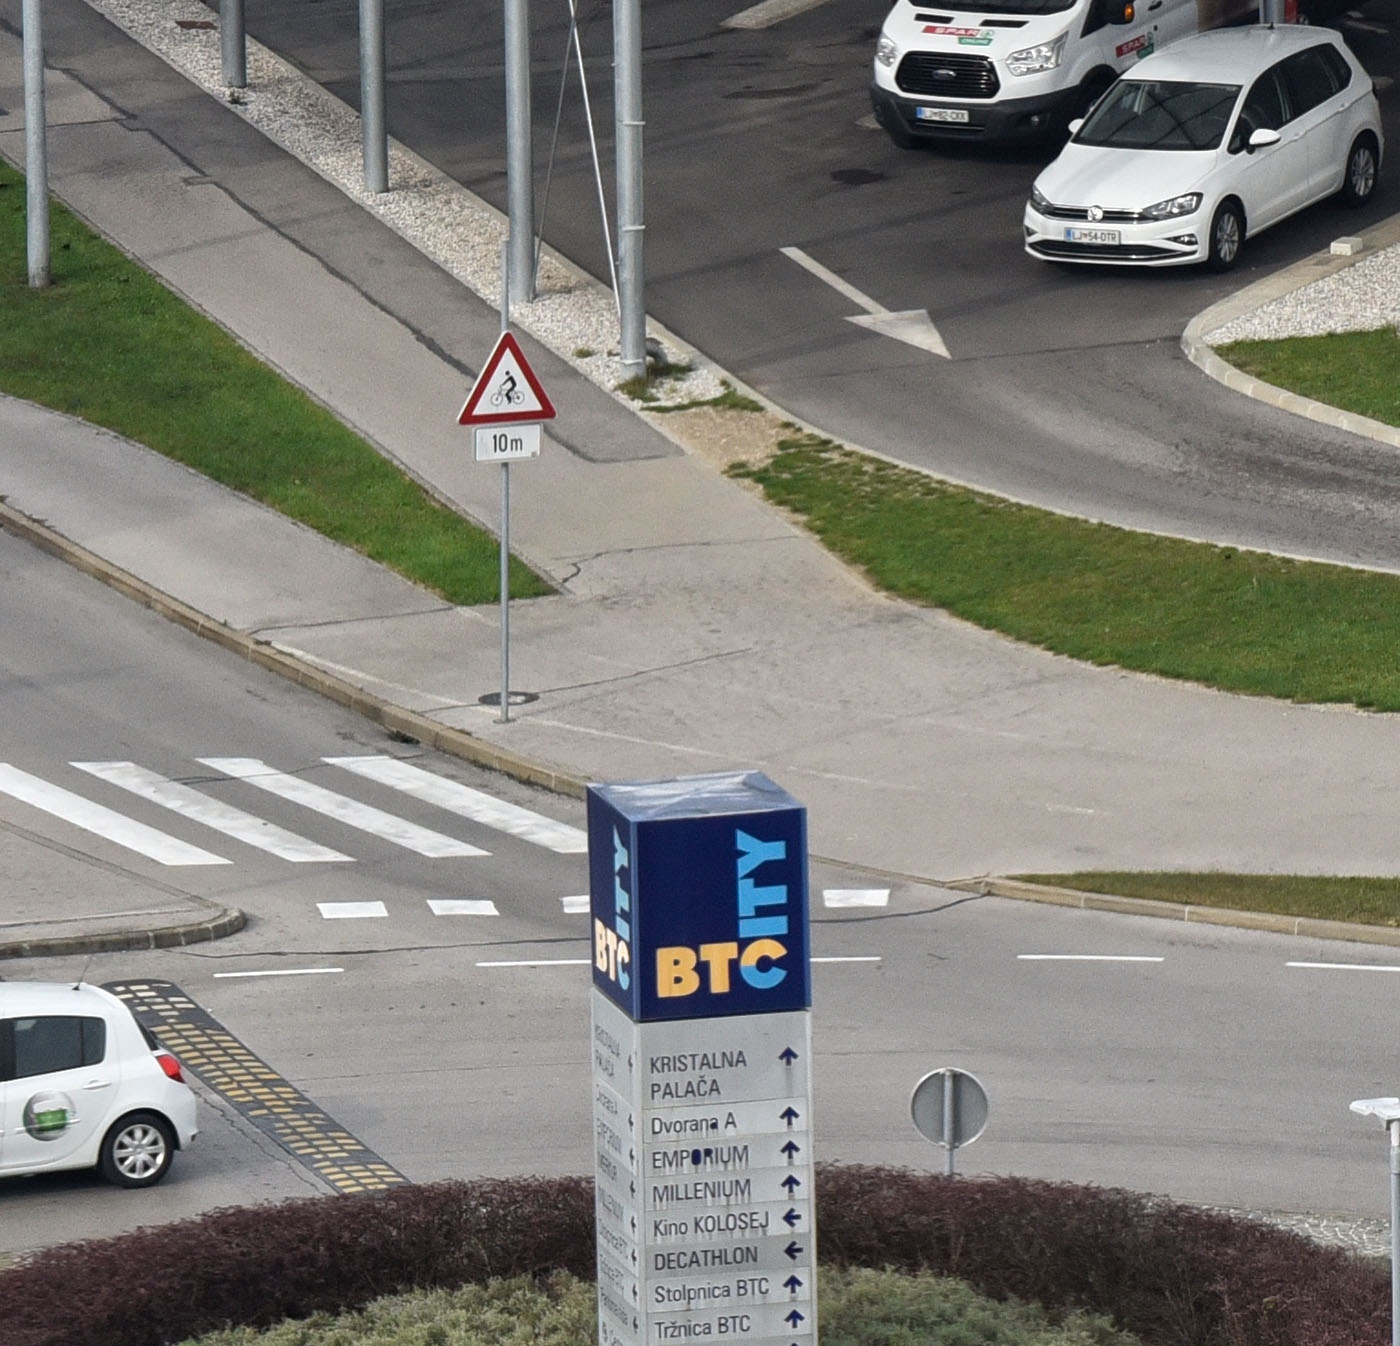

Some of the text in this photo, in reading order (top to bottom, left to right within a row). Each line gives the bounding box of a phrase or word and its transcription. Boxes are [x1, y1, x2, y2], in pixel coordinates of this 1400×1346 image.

[934, 27, 978, 37] SPAR
[493, 433, 523, 453] 10 m
[594, 917, 631, 991] BTC
[656, 938, 789, 998] BTC
[650, 1050, 747, 1074] KRISTALNA
[650, 1074, 721, 1101] PALAČA
[651, 1112, 737, 1135] Dvorana A
[651, 1145, 750, 1169] EMPORIUM
[652, 1179, 752, 1203] MILLENIUM
[653, 1211, 770, 1237] Kino KOLOSEJ
[654, 1246, 758, 1271] DECATHLON
[654, 1277, 770, 1304] Stolpnica BTC
[654, 1315, 751, 1339] Tržnica BTC
